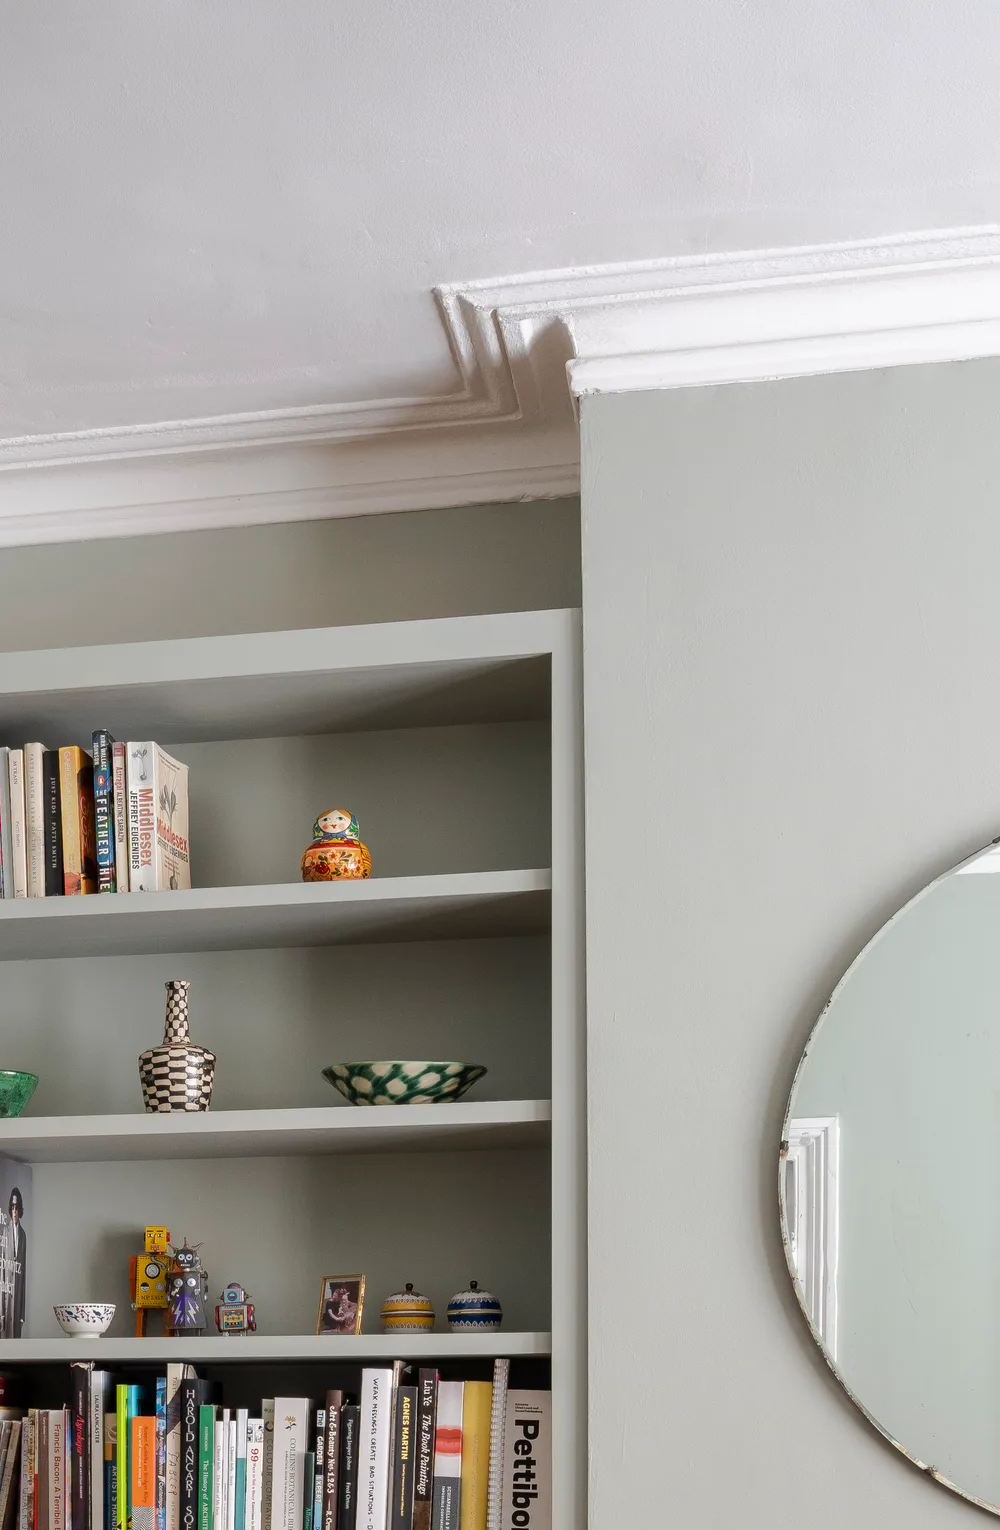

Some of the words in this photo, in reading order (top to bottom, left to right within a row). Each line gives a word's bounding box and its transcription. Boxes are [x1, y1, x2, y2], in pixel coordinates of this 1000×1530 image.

[130, 791, 139, 824] JEFFREY
[139, 788, 154, 866] Middlesex
[131, 826, 140, 870] EUGENIDES
[185, 1389, 196, 1442] HAROLD
[370, 1403, 378, 1435] MESSAGES
[402, 1396, 411, 1426] AGNES
[400, 1427, 409, 1460] MARTIN
[185, 1445, 194, 1498] ANCART
[367, 1480, 375, 1516] SITUATIONS
